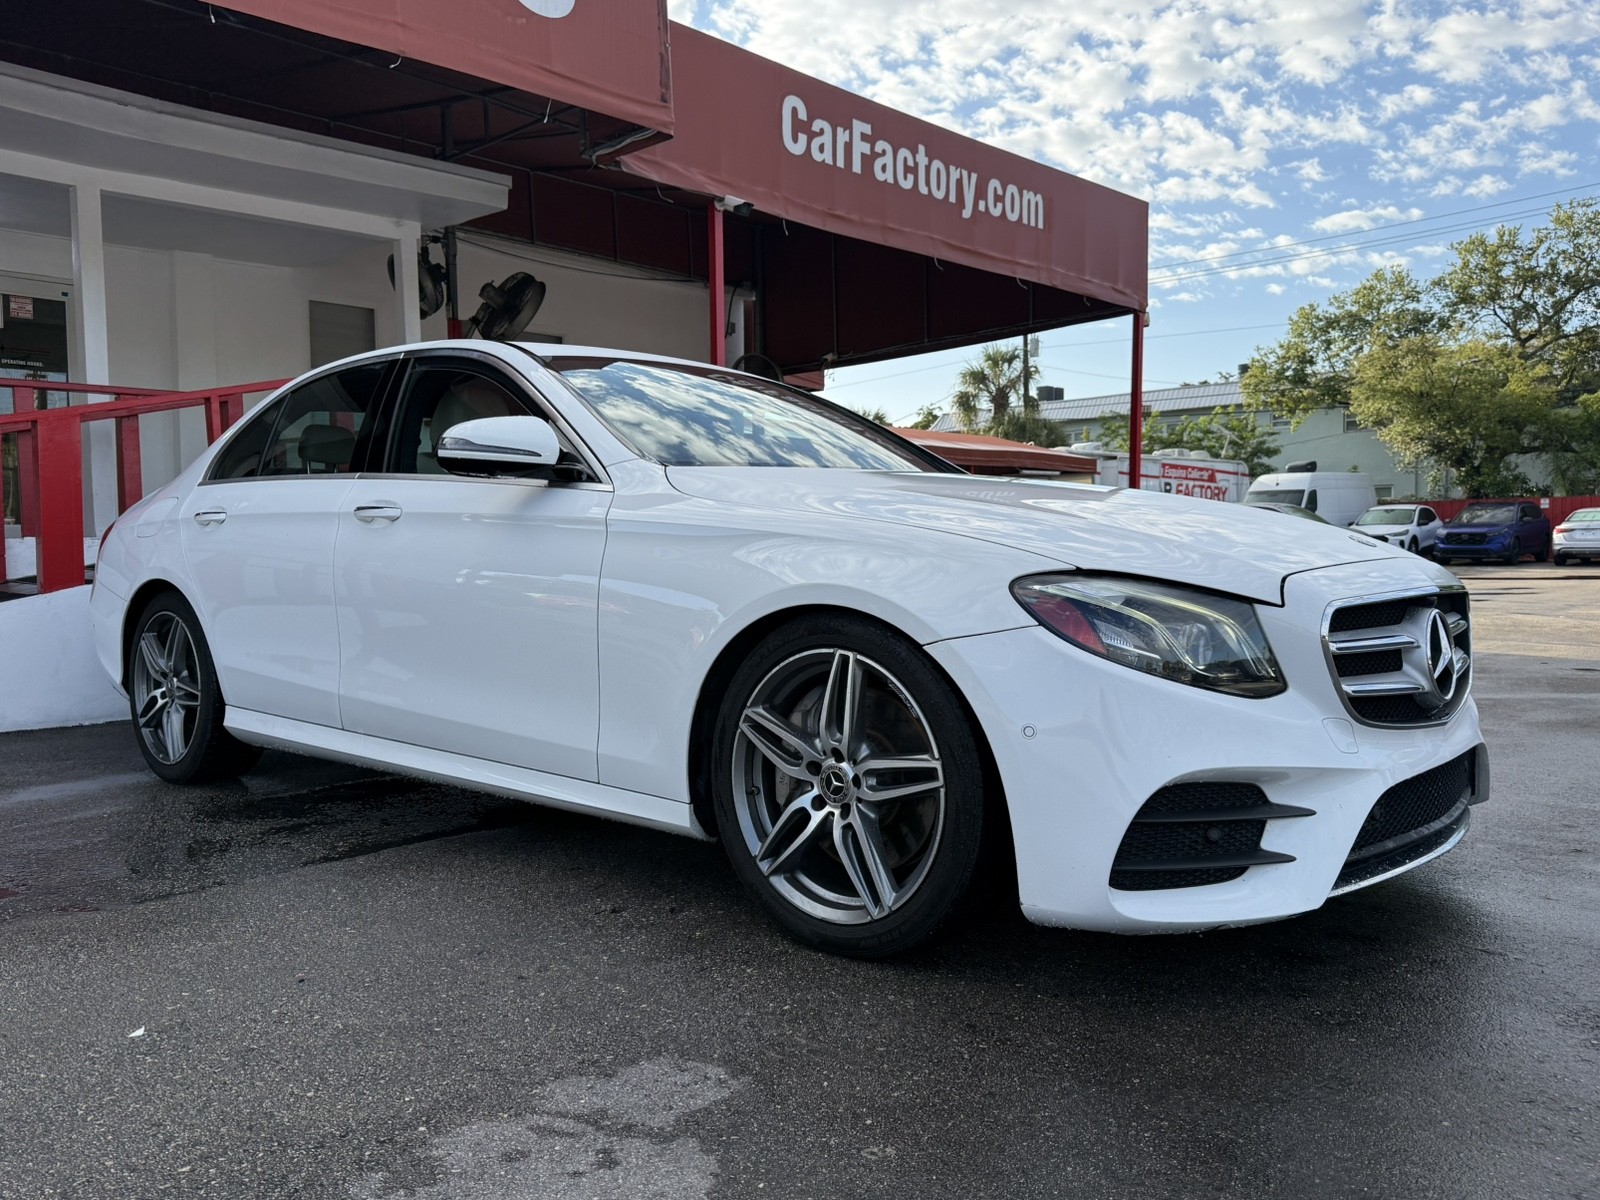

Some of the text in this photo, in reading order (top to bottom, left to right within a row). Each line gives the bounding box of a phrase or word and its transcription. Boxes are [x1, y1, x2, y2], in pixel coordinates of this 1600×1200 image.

[781, 94, 1044, 230] CarFactory.com
[1, 358, 26, 366] OPERATING
[1176, 483, 1228, 501] FACTORY
